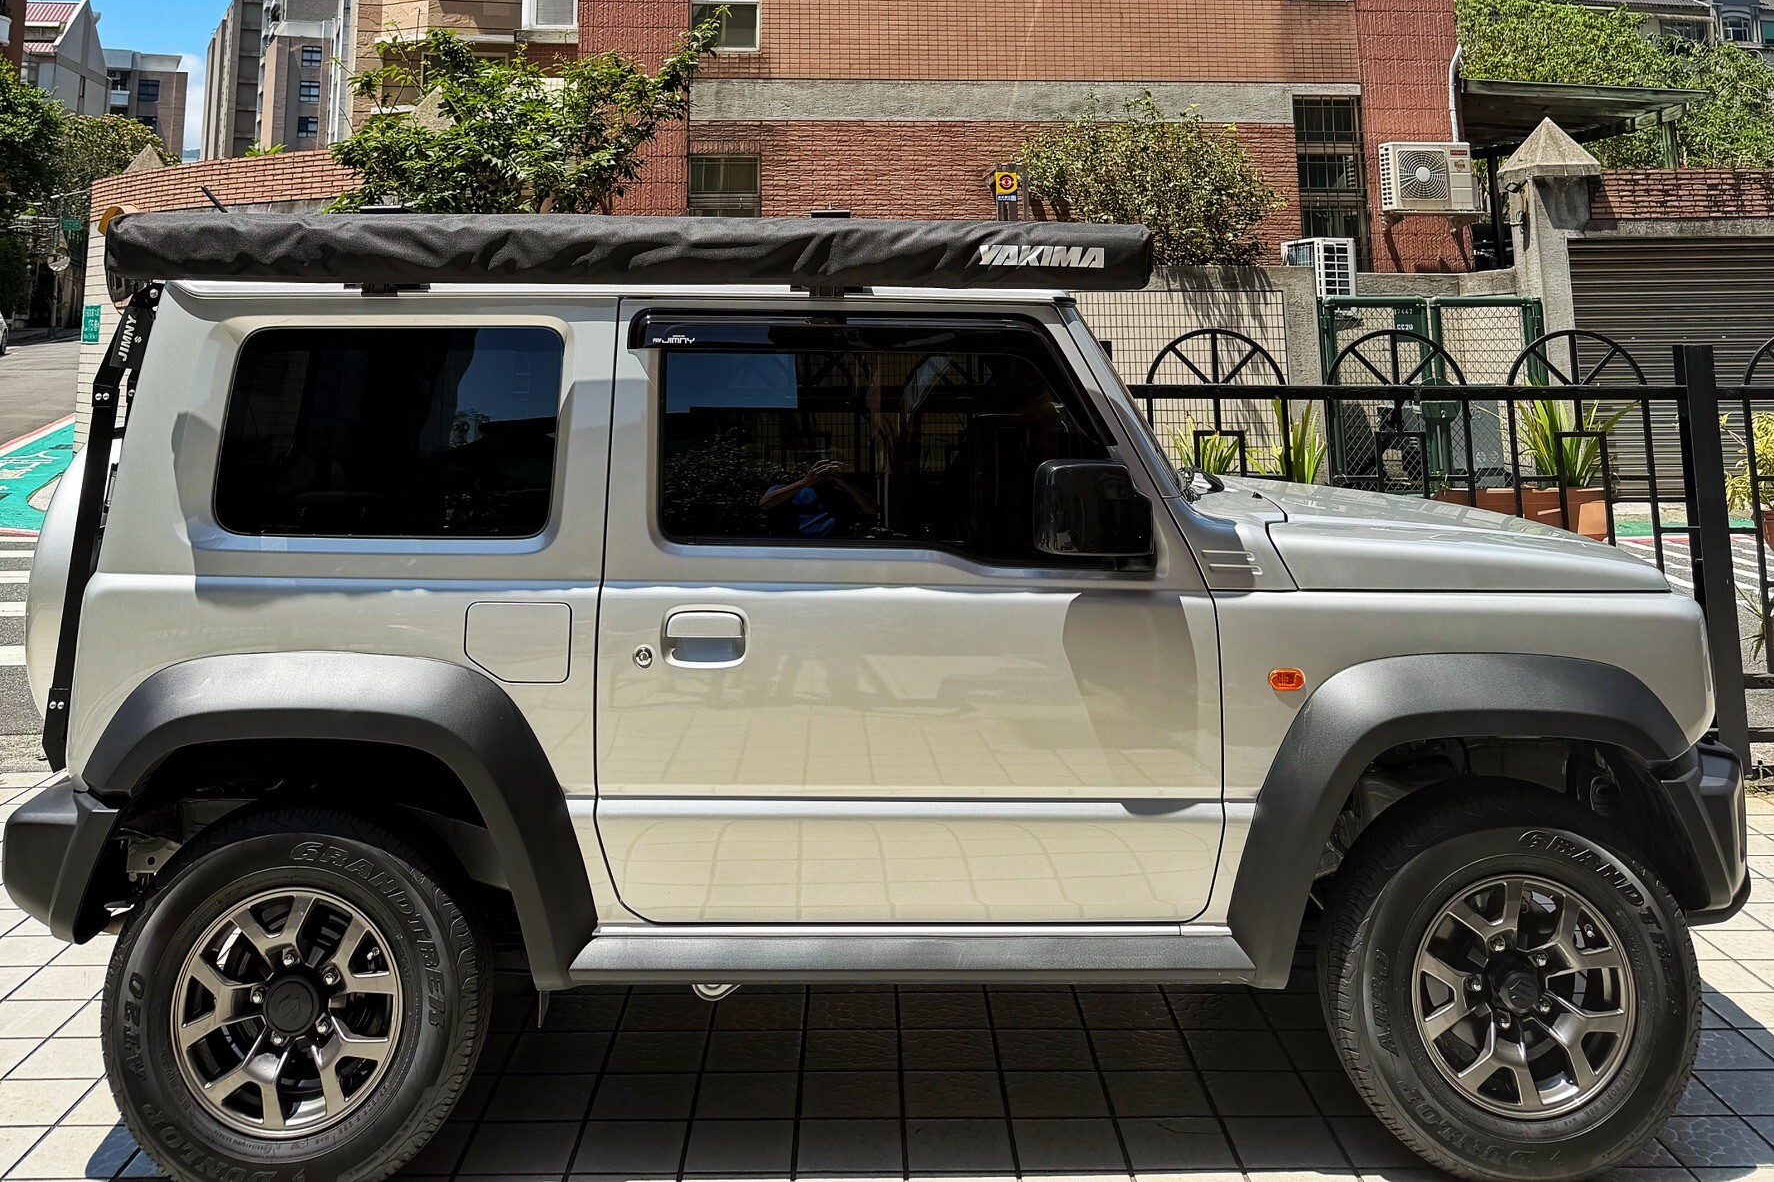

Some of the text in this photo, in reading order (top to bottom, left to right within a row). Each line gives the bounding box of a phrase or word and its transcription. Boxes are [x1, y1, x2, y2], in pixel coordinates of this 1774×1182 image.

[978, 244, 1105, 269] YAKIMA
[118, 314, 137, 362] JIMNY
[288, 841, 446, 1029] GRANDTREK
